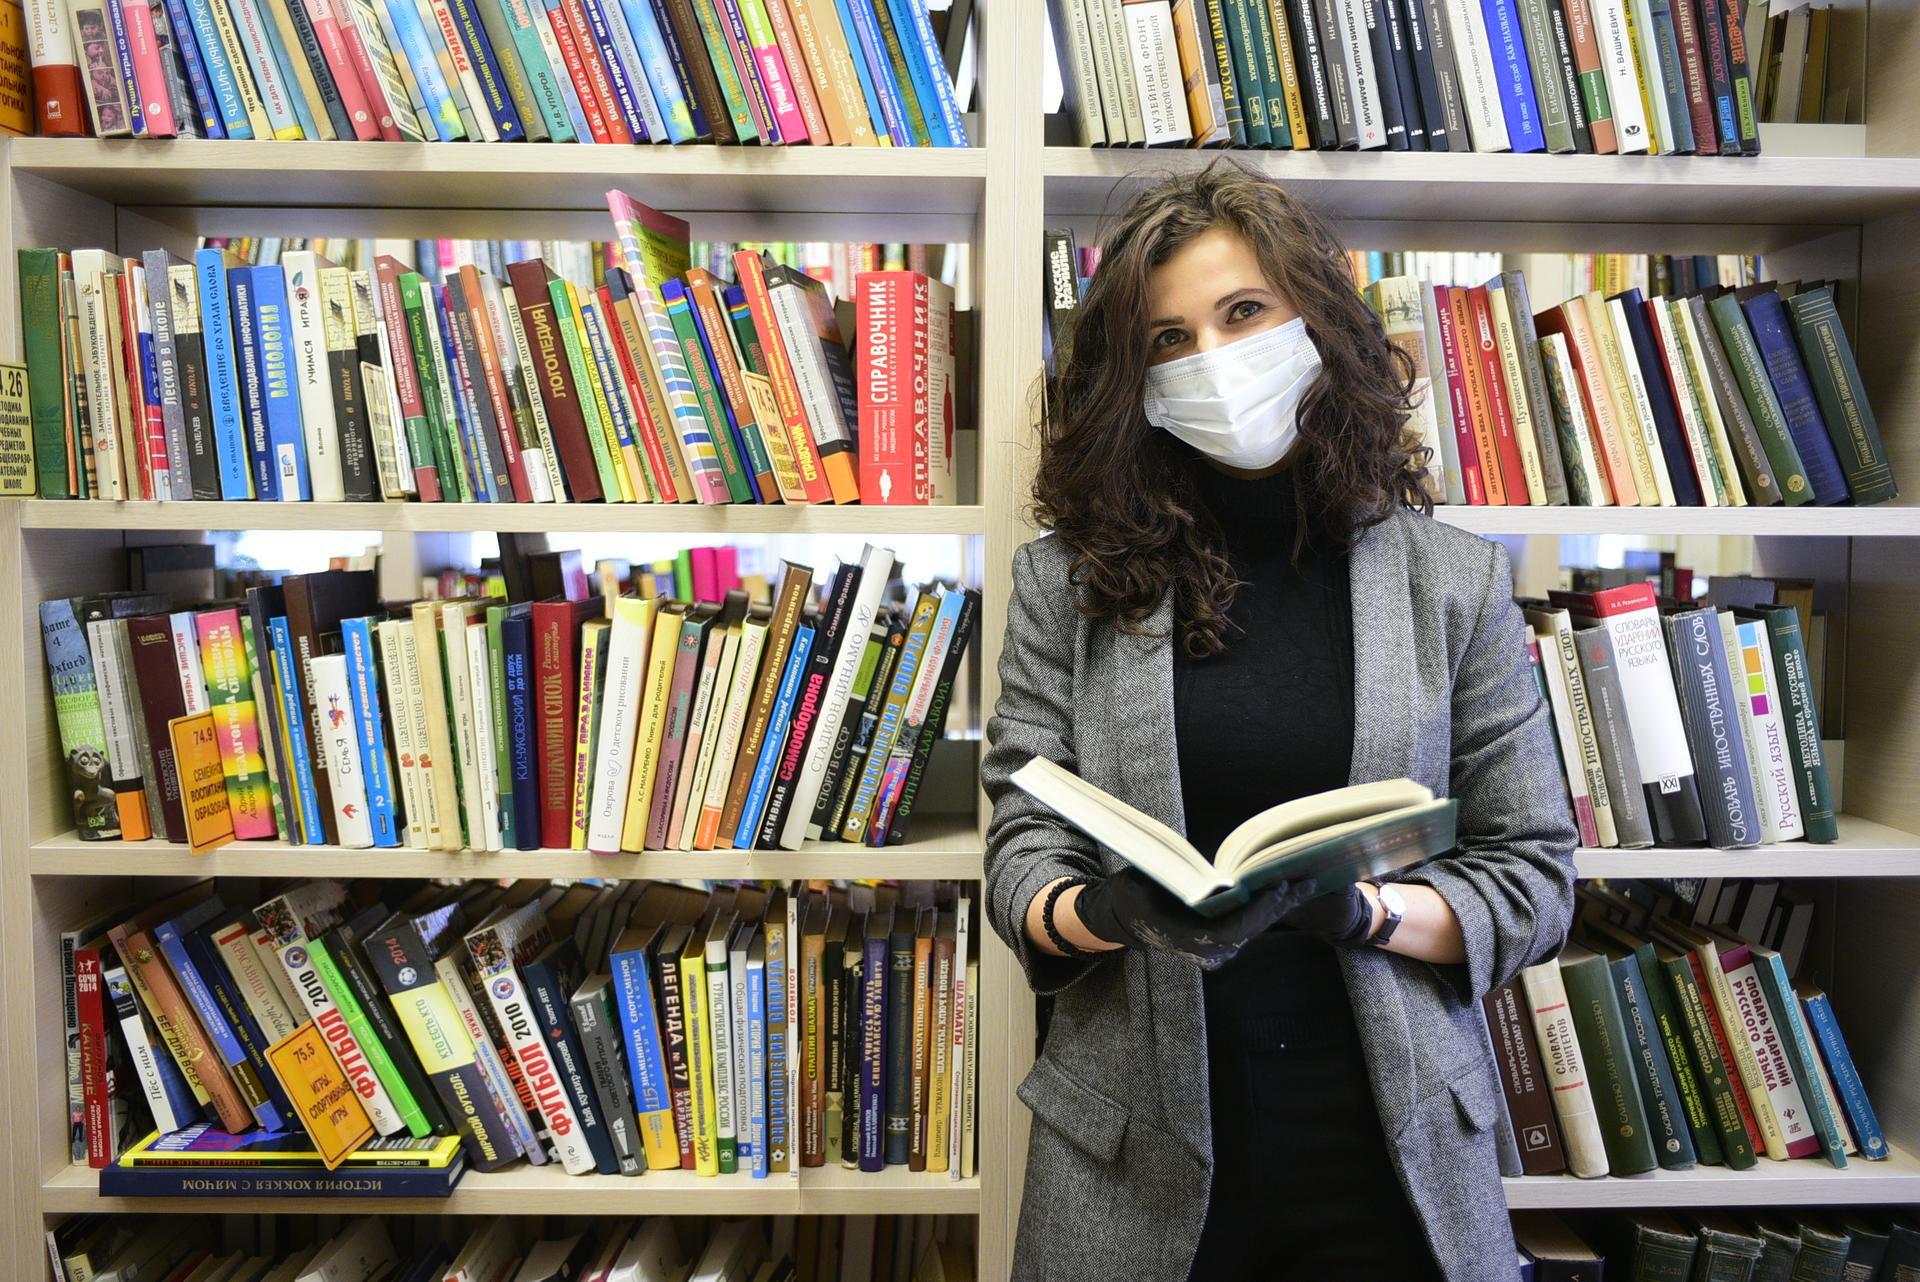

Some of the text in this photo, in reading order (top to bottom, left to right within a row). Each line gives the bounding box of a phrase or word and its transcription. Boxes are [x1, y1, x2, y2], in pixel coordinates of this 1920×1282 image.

[437, 8, 469, 72] РУМЯНЫЕ
[799, 13, 822, 66] ПРОФЕССИЯ
[1077, 20, 1098, 117] БЕЛАЯ КНИГА НАРОДА
[1136, 17, 1163, 134] МУЗЕЙНЫЙ ФРОНТ
[1149, 14, 1176, 132] ВЕЛИКОЙ ОТЕЧЕСТВЕННОЙ
[1216, 41, 1235, 101] РУССКИЕ
[1274, 6, 1296, 88] СОВРЕМЕННЫЙ
[1470, 48, 1485, 93] СОВЕТСКОГО
[1496, 6, 1516, 60] КАК НАЗВАТЬ
[1552, 9, 1583, 128] ВВЕДЕНИЕ ЯЗЫКОЗНАНИЕ
[1608, 7, 1625, 64] ВАШКЕВИЧ
[1706, 22, 1725, 83] ДОРОГАМИ
[127, 80, 140, 117] Лучшие
[217, 69, 238, 117] ЧИТАТЬ
[622, 94, 642, 134] ПОИГРАЕМ
[1311, 54, 1329, 120] ЯЗЫКОЗНАНИЕ
[1351, 42, 1373, 126] НАШИХ ФАМИЛИЙ
[1688, 56, 1702, 104] ВВЕДЕНИЕ
[87, 301, 105, 434] ЗАНИМАТЕЛЬНОЕ АЗБУКОВЕДЕНИЕ
[154, 301, 177, 406] Лесков школе
[205, 264, 232, 413] ВВЕДЕНИЕ ХРАМ СЛОВА
[236, 284, 265, 452] МЕТОДИКА ПРЕПОДАВАНИЯ ИНФОРМАТИКИ
[260, 305, 288, 398] ВАЛЕОЛОГИЯ
[298, 292, 317, 385] УЧИМСЯ ИГРАЯ
[531, 308, 567, 398] ЛОГОПЕДИЯ
[870, 281, 888, 404] СПРАВОЧНИК
[889, 280, 898, 402] ДЛЯ ПОСТУПАЮЩИХ ВУЗЫ
[1729, 325, 1760, 394] ПРИЛАГАТЕЛЬНЫХ
[508, 304, 560, 487] ПРАКТИКУМ ДЕТСКОЙ ЛОГОПЕДИИ
[914, 281, 926, 500] СПРАВОЧНИК
[1455, 298, 1499, 495] ЛИТЕРАТУРА УРОКАХ РУССКОГО ЯЗЫКА
[1507, 360, 1527, 426] Путешествие
[1578, 327, 1622, 468] ОРФОГРАФИЯ ПУНКТУАЦИЯ
[1696, 311, 1761, 469] СЛОВАРЬ АНТОНИМОВ РУССКОГО ЯЗЫКА
[192, 416, 203, 456] ШМЕЛЕВ
[348, 420, 361, 477] СЕРЕБРЯНОГО
[791, 422, 817, 482] СПРАВОЧНИК
[826, 571, 853, 638] Сэмми Франко
[1615, 617, 1656, 634] СЛОВАРЬ
[221, 625, 240, 694] СВОБОДЫ
[384, 635, 410, 749] РАЗГОВОР МАТЕРЬЮ
[506, 654, 516, 678] ДВУХ
[514, 654, 524, 677] ПЯТИ
[746, 583, 801, 756] Ребенок церебральным параличом
[1618, 641, 1662, 659] РУССКОГО
[225, 694, 249, 783] ПЕДАГОГИКА
[412, 698, 428, 749] РАЗГОВОР
[511, 694, 529, 780] К.И.ЧУКОВСКИЙ
[543, 672, 566, 811] БЕНДЖАМИН СПОК
[574, 647, 593, 830] ДЕТСКИЕ ПРАЗДНИКИ
[603, 656, 630, 818] Озерова детском рисовании
[637, 660, 666, 803] А.С.МАКАРЕНКО для родителей
[721, 700, 742, 761] СЕМЕЙНЫЕ
[811, 633, 863, 773] СТАДИОН ДИНАМО
[851, 704, 901, 814] ЭНЦИКЛОПЕДИЯ
[891, 633, 927, 696] СПОРТА
[1559, 627, 1609, 807] СЛОВАРЬ ИНОСТРАННЫХ СЛОВ
[1692, 616, 1748, 842] СЛОВАРЬ ИНОСТРАННЫХ СЛОВ
[1783, 652, 1811, 769] МЕТОДИКА РУССКОГО
[1807, 727, 1820, 766] ЯЗЫКА
[762, 674, 824, 842] АКТИВНАЯ самооборона
[816, 769, 835, 810] СПОРТ
[832, 726, 850, 759] СССР
[899, 679, 951, 817] ФИТНЕС ДЛЯ ДВОИХ
[1661, 779, 1678, 791] XXI
[236, 786, 247, 816] Юрий
[247, 783, 258, 820] Азаров
[1771, 766, 1795, 830] Русский
[78, 973, 97, 983] СОЧИ
[385, 937, 407, 966] 2014
[299, 969, 377, 1099] ФУТБОЛ 2010
[620, 959, 660, 1109] 115 ЗНАМЕНИТЫХ СПОРТСМЕНОВ
[662, 962, 688, 1081] ЛЕГЕНДА 17
[713, 982, 730, 1129] ТУРИСТИЧЕСКИЙ КОМПЛЕКС РОССИИ
[768, 959, 785, 1144] ЭНЦИКЛОПЕДИЯ СПОРТА
[954, 979, 964, 1045] ШАХМАТЫ
[1495, 998, 1523, 1095] СЛОВАРЬ-СПРАВОЧНИК
[1504, 988, 1532, 1075] РУССКОМУ ЯЗЫКУ
[1545, 1023, 1566, 1075] СЛОВАРЬ
[1557, 1018, 1579, 1073] ЭПИТЕТОВ
[1693, 1029, 1712, 1074] СЛОВАРЬ
[1732, 981, 1778, 1091] РУССКОГО ЯЗЫКА
[1746, 976, 1792, 1087] СЛОВАРЬ УДАРЕНИЙ
[415, 999, 498, 1160] МИРОВОЙ ФУТБОЛ: КТО ЕСТЬ КТО
[504, 1002, 573, 1136] ФУТБОЛ 2010
[557, 1040, 591, 1106] кумир-хоккей
[736, 982, 749, 1132] Общая физическая подготовка
[1632, 1006, 1674, 1136] СЛОВАРЬ ТРУДНОСТЕЙ РУССКОГО
[329, 1104, 349, 1126] ИГРЫ
[675, 1090, 689, 1154] ХАРЛАМОВ
[182, 1179, 382, 1191] ИСТОРИЯ ХОККЕЯ МЯЧОМ
